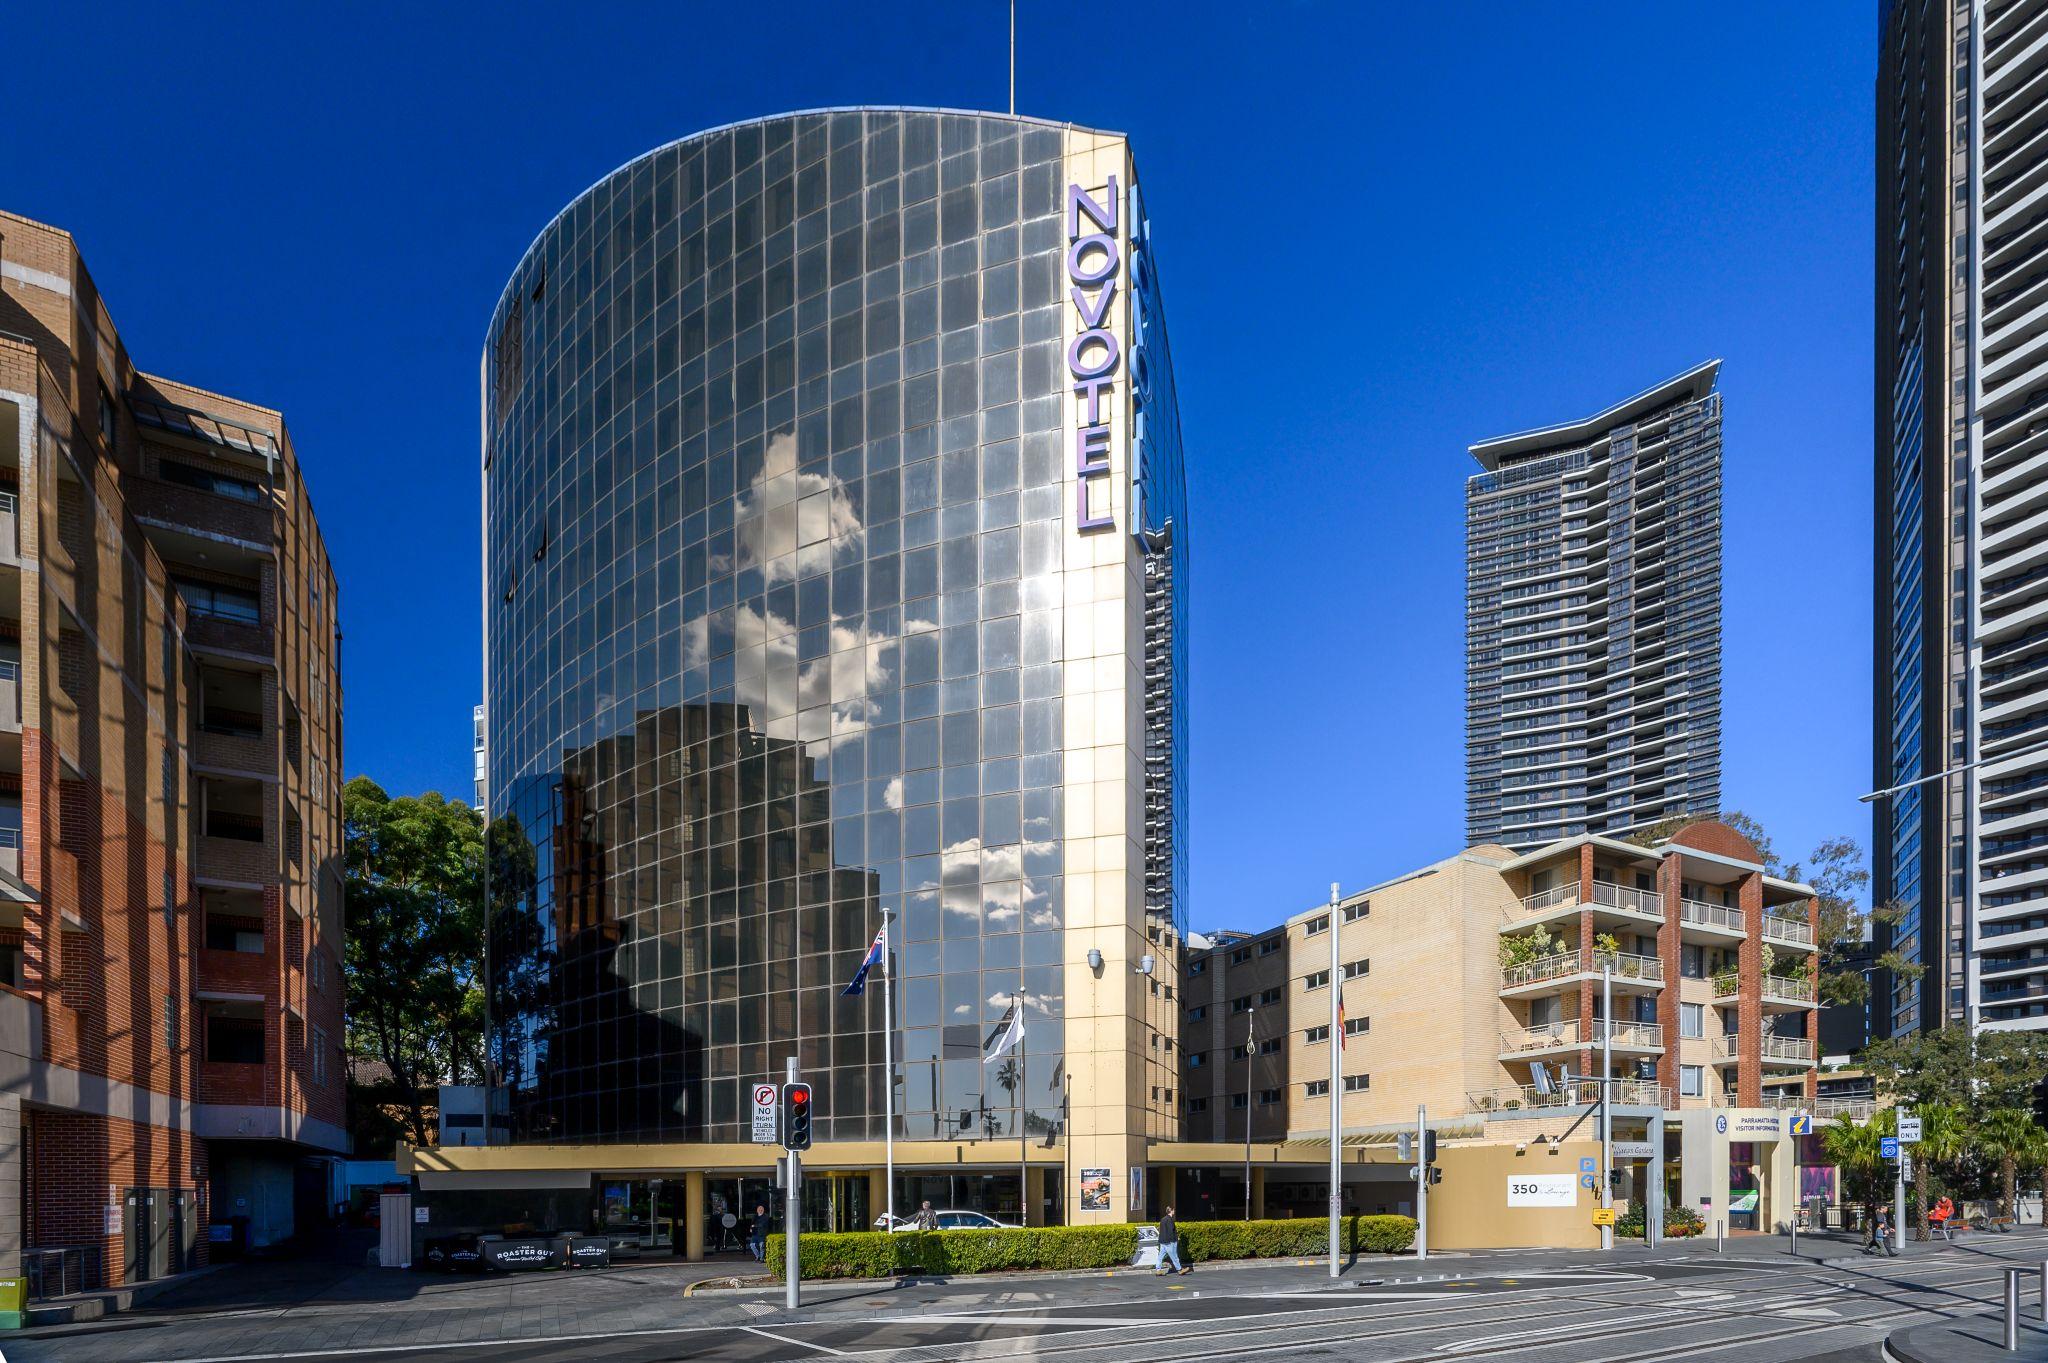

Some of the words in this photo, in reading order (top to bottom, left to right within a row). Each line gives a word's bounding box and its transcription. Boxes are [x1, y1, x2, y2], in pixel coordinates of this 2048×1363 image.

[1068, 174, 1119, 535] NOVOTEL
[759, 1107, 771, 1115] NO
[1512, 1184, 1538, 1194] 350
[497, 1249, 536, 1260] ROASTER
[536, 1249, 555, 1257] GUY
